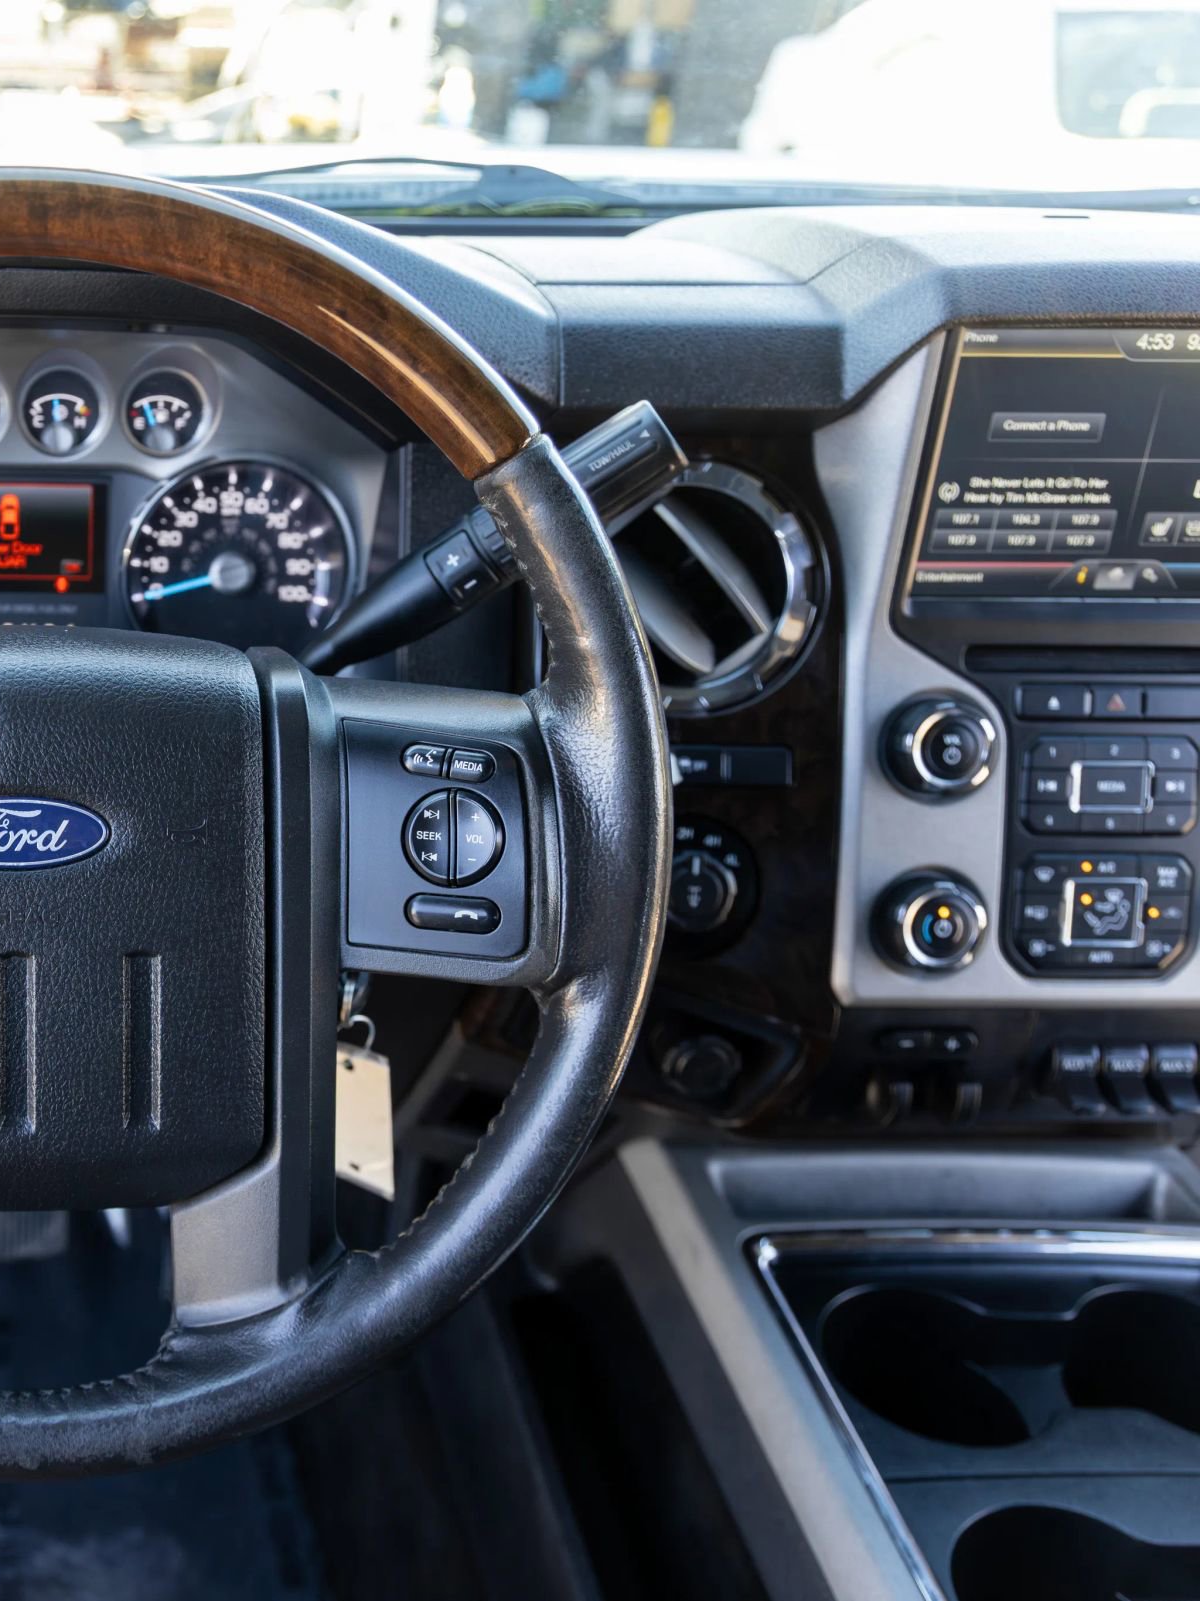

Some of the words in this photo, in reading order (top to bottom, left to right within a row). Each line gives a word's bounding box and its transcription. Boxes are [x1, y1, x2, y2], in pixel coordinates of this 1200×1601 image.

[1136, 333, 1176, 351] 4:53
[587, 439, 636, 472] TOW/HAUL
[192, 497, 217, 514] 40
[174, 511, 198, 528] 30
[266, 512, 289, 529] 70
[157, 530, 183, 547] 20
[150, 556, 170, 574] 10
[453, 759, 483, 773] MEDIA
[416, 830, 442, 841] SEEK
[466, 834, 484, 844] VOL
